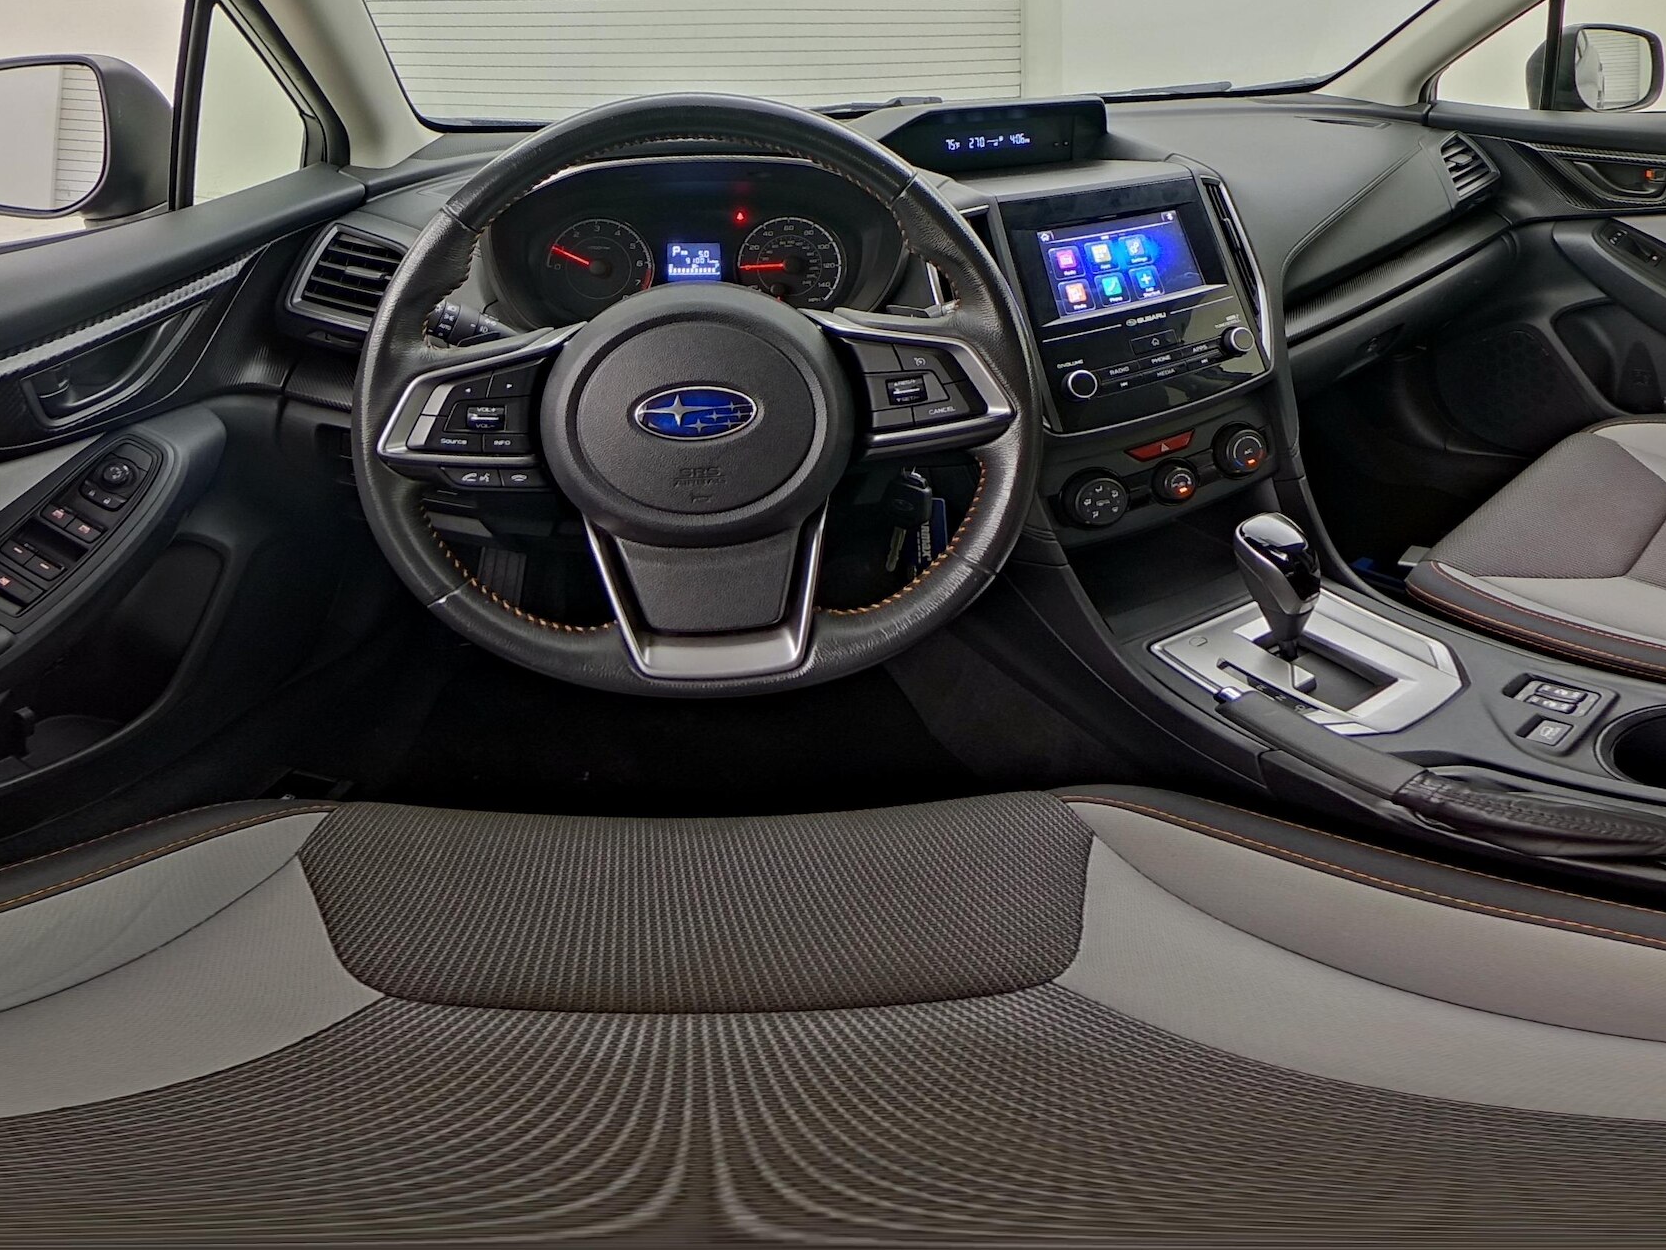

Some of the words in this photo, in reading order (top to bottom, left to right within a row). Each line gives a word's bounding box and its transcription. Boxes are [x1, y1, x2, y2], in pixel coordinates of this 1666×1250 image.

[968, 136, 985, 149] 270
[672, 245, 681, 257] P
[1136, 312, 1166, 324] SUBARU
[1192, 344, 1208, 352] APPS
[1151, 354, 1172, 364] PHONE
[1109, 366, 1130, 376] RADIO
[1156, 368, 1176, 378] MEDIA
[928, 406, 956, 415] CANCEL
[679, 467, 722, 478] SRS
